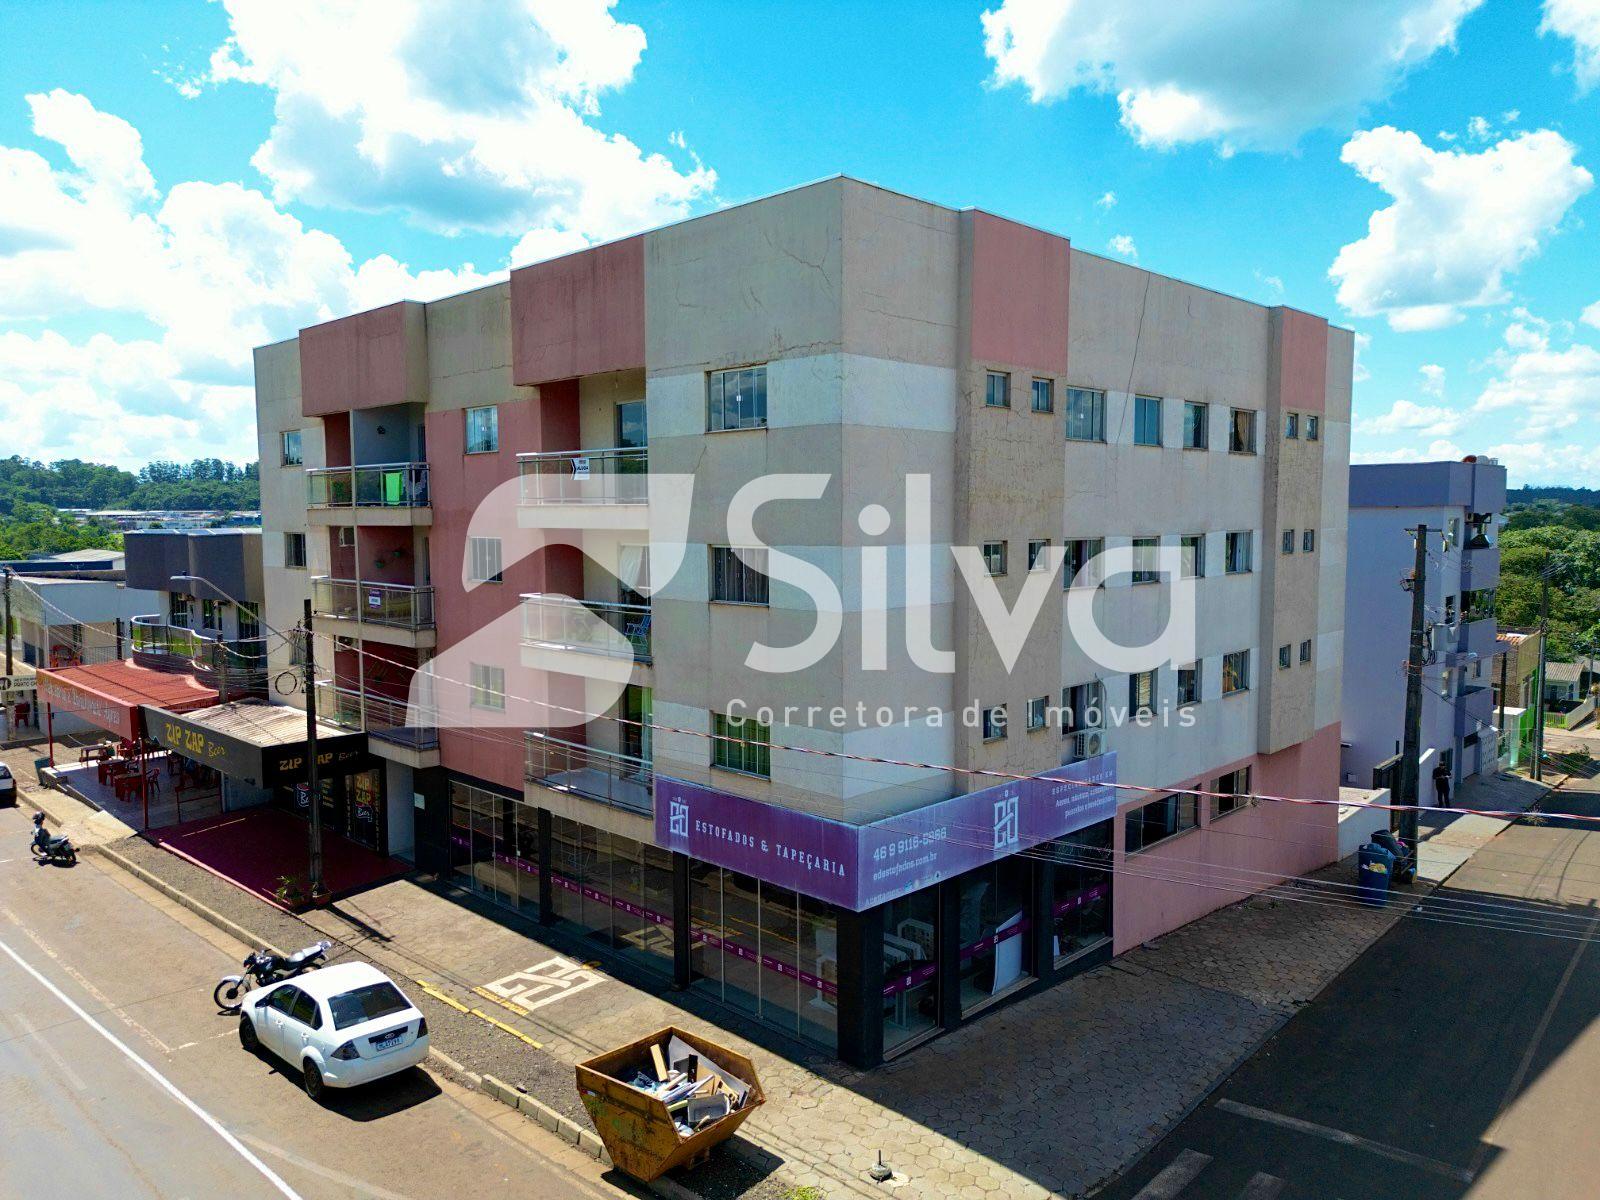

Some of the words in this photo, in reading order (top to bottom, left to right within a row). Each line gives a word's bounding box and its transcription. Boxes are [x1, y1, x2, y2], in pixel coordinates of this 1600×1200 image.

[165, 722, 182, 747] ZIP
[184, 729, 205, 754] ZAP
[280, 758, 302, 771] ZIP
[695, 819, 755, 848] ESTOFADOS
[760, 840, 769, 854] &
[776, 844, 845, 877] TAPEÇARIA
[873, 846, 887, 861] 46
[889, 843, 896, 857] 9
